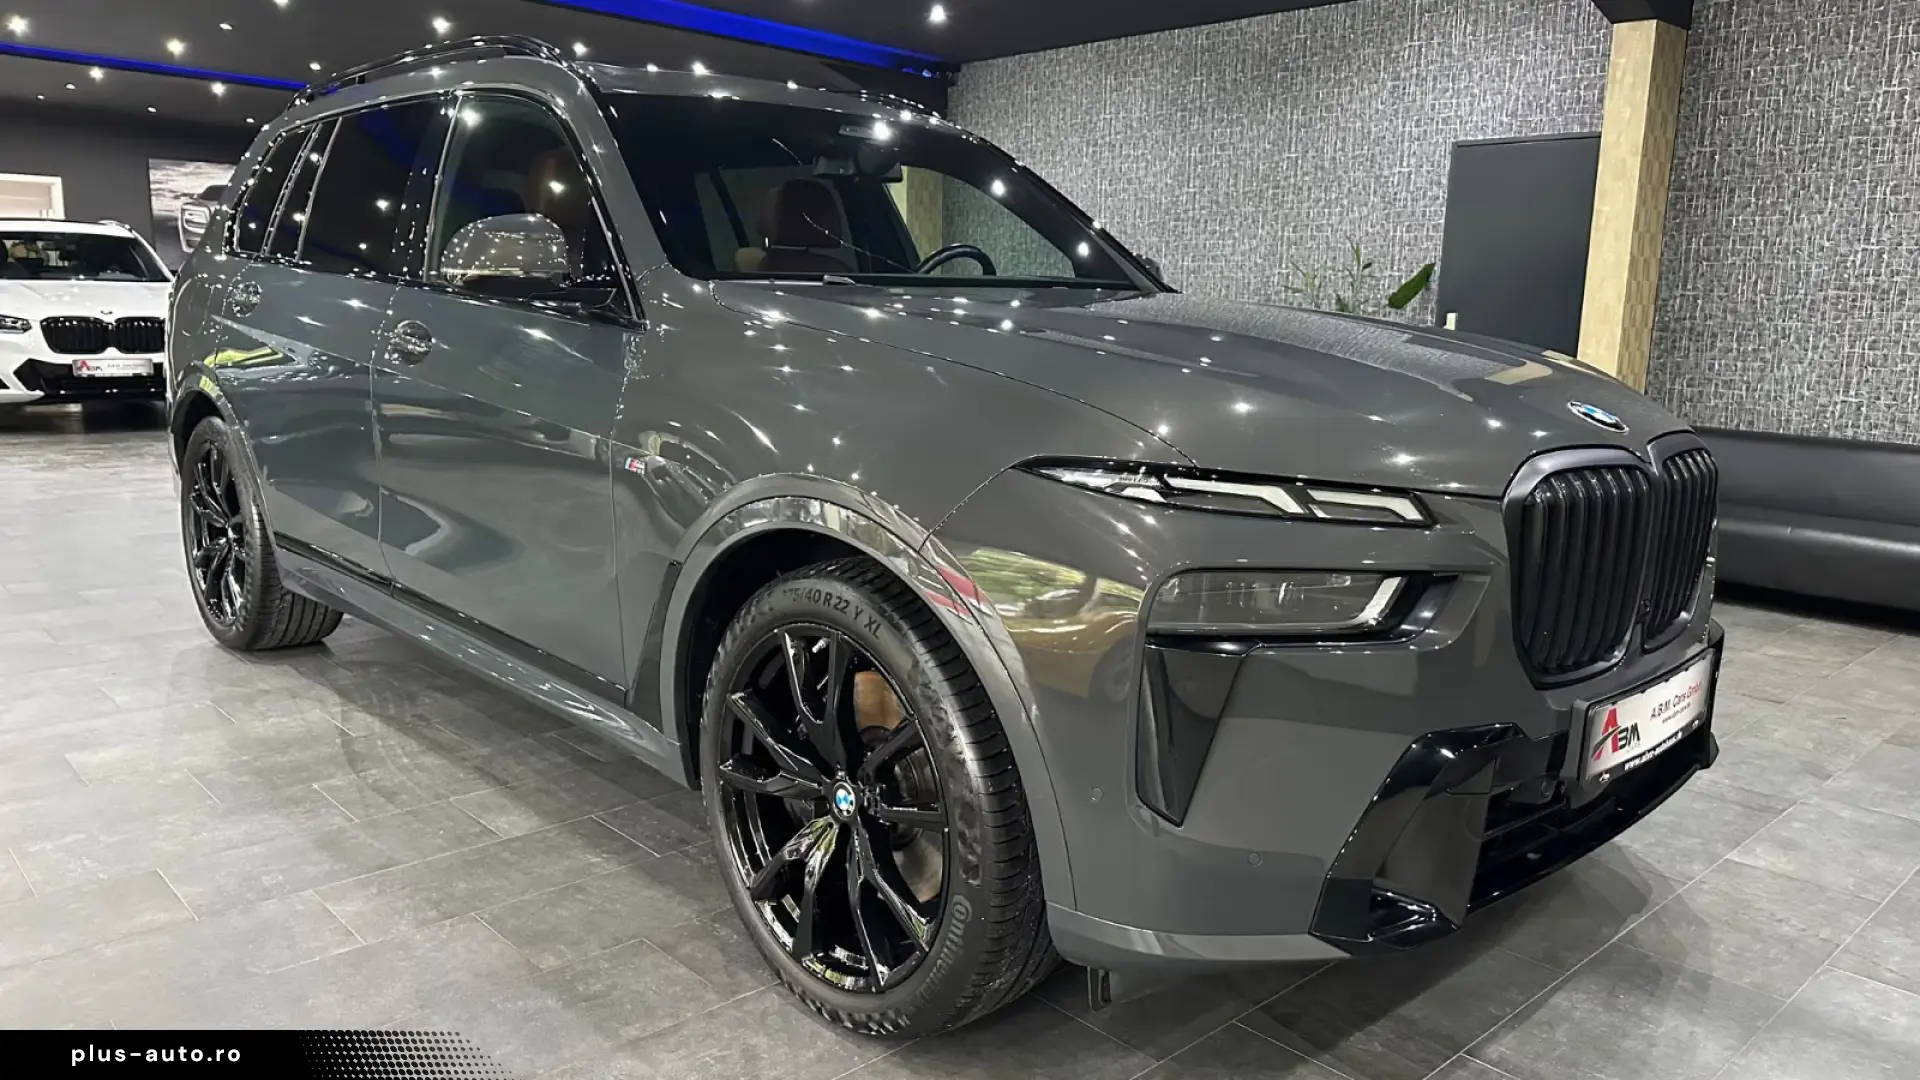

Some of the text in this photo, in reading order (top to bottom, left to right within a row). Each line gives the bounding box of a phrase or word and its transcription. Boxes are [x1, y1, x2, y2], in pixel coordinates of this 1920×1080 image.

[823, 591, 833, 607] R
[833, 595, 850, 616] 22
[853, 605, 864, 621] Y
[863, 613, 882, 639] XL
